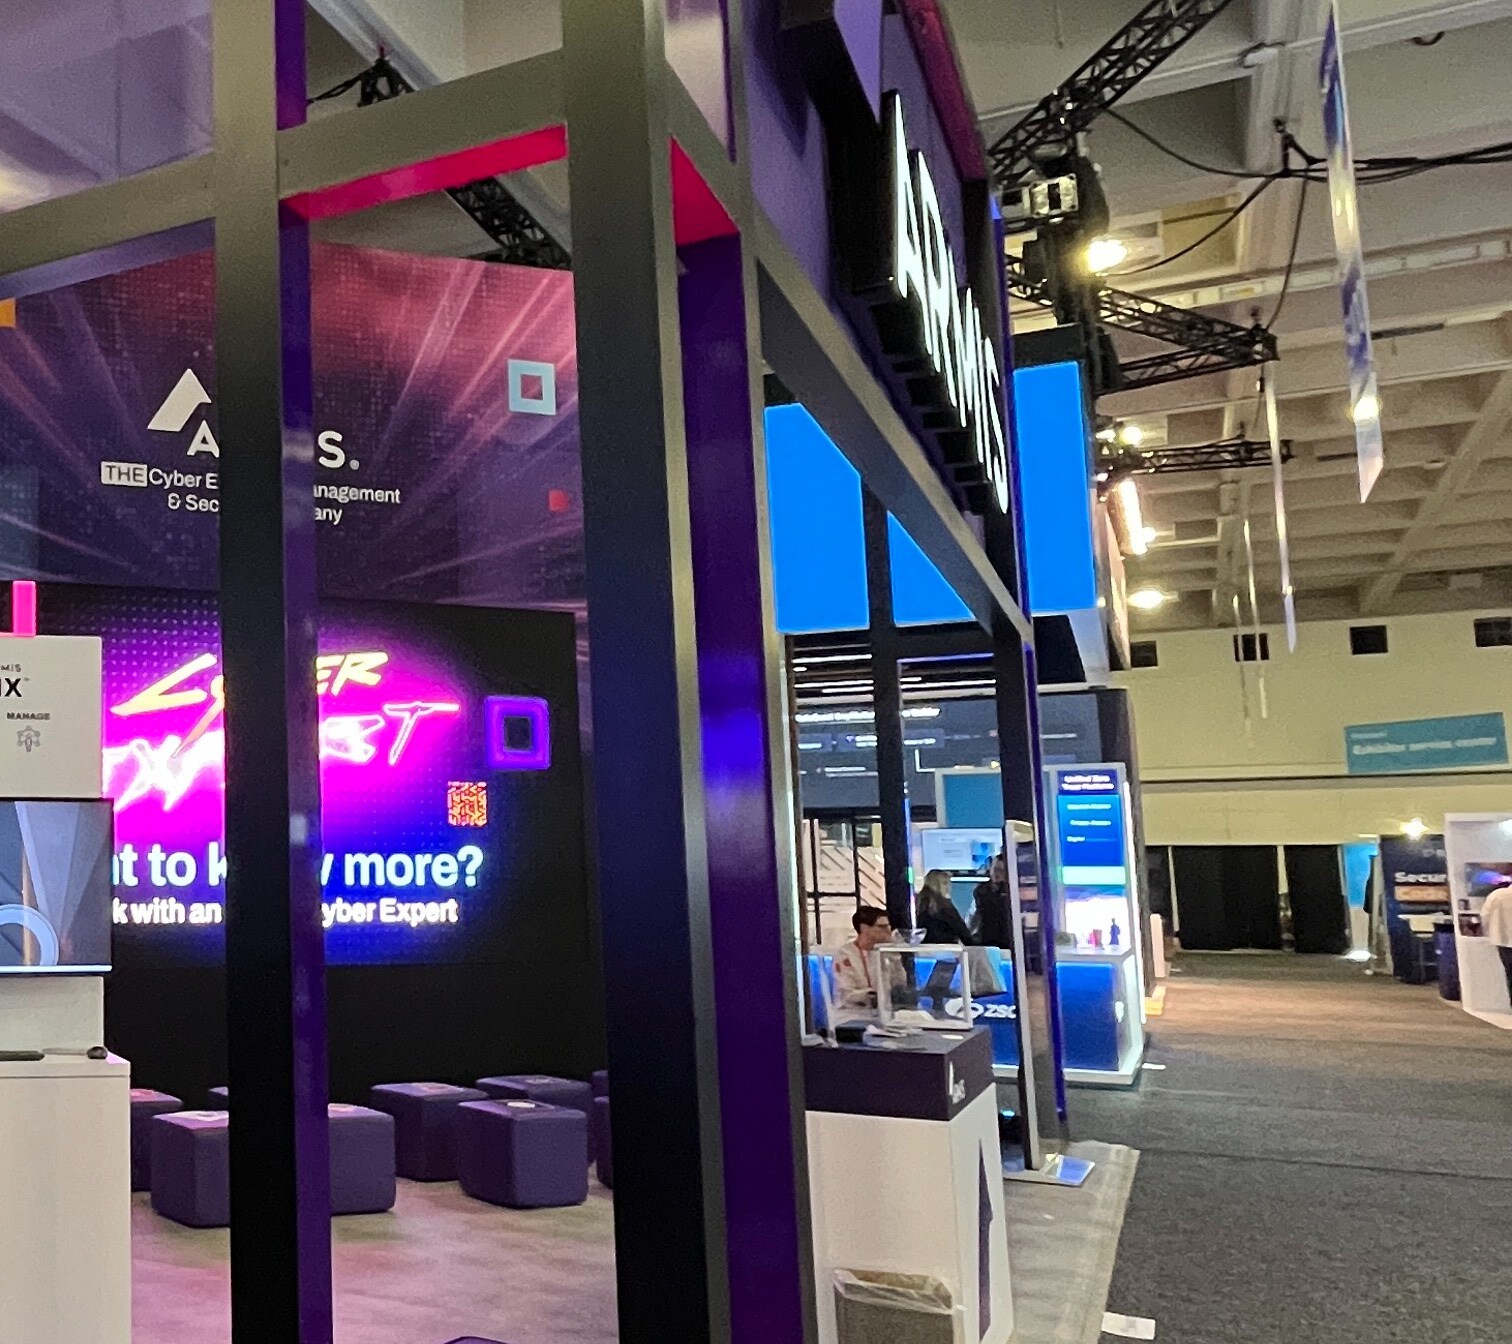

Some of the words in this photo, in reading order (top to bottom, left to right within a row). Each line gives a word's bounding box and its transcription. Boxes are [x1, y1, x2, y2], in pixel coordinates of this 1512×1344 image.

[104, 464, 145, 484] THE
[147, 467, 202, 490] Cyber
[312, 483, 401, 505] anagement
[6, 711, 51, 721] MANAGE
[147, 843, 197, 887] to
[343, 845, 485, 888] more?
[131, 897, 186, 925] with
[188, 902, 223, 925] an
[379, 897, 460, 929] Expert
